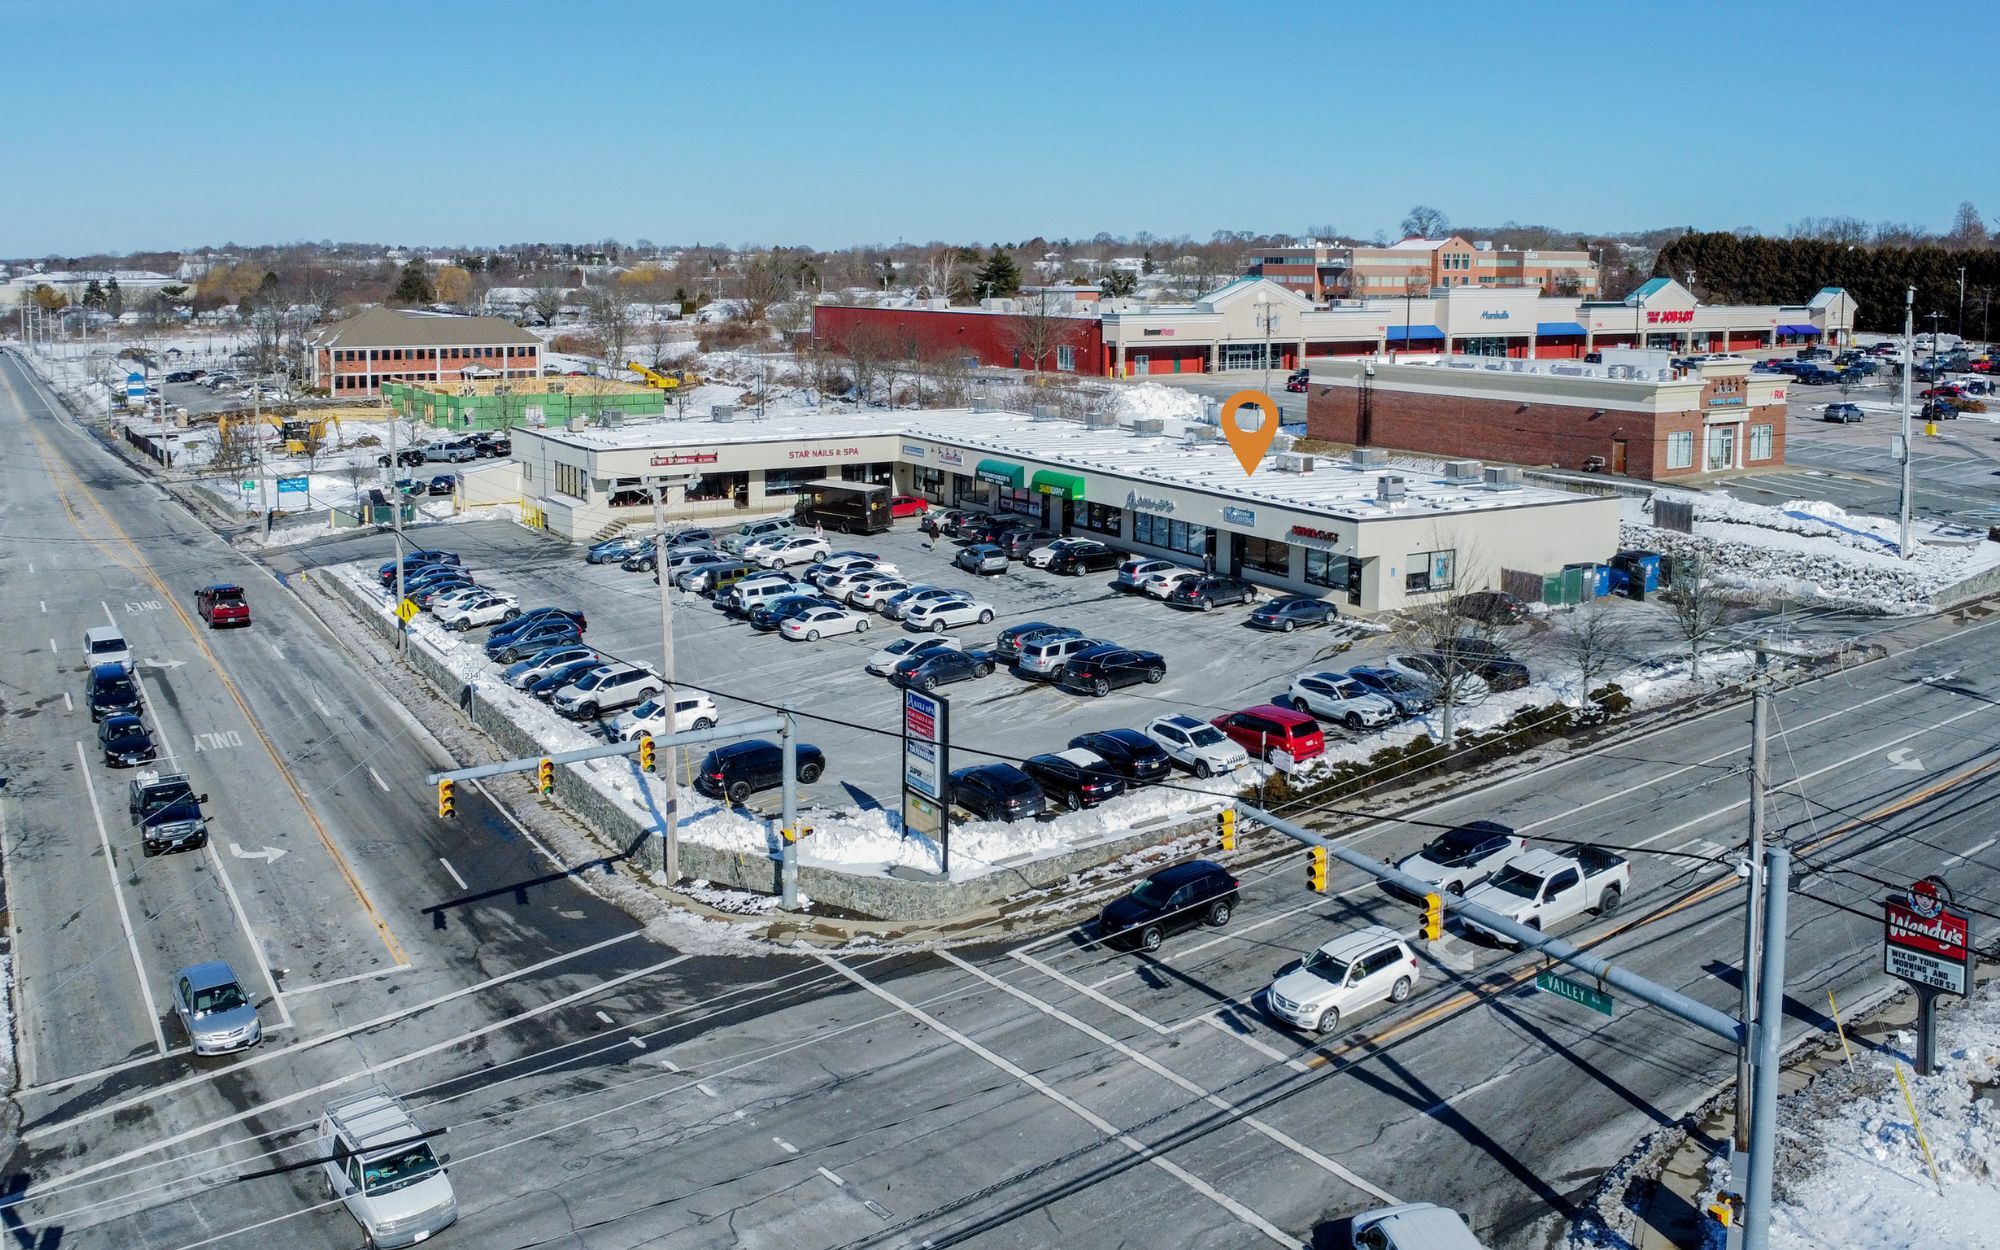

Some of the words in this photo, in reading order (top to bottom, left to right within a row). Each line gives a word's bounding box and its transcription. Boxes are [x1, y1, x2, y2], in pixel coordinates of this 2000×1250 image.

[1480, 310, 1509, 320] Marshalls
[1774, 390, 1784, 399] RK
[789, 450, 809, 459] STAR
[812, 449, 834, 457] NAILS
[844, 448, 859, 456] SPA
[125, 600, 163, 612] ONLY
[193, 730, 243, 752] ONLY
[1890, 913, 1962, 950] Wendy's
[1892, 949, 1906, 960] MIX
[1907, 953, 1917, 962] UP
[1920, 957, 1939, 969] YOUR
[1893, 958, 1927, 974] MORNING
[1933, 970, 1948, 980] AND
[1896, 967, 1915, 979] PICK
[1923, 975, 1928, 983] 2
[1930, 977, 1944, 987] FOR
[1547, 975, 1585, 1002] VALLEY
